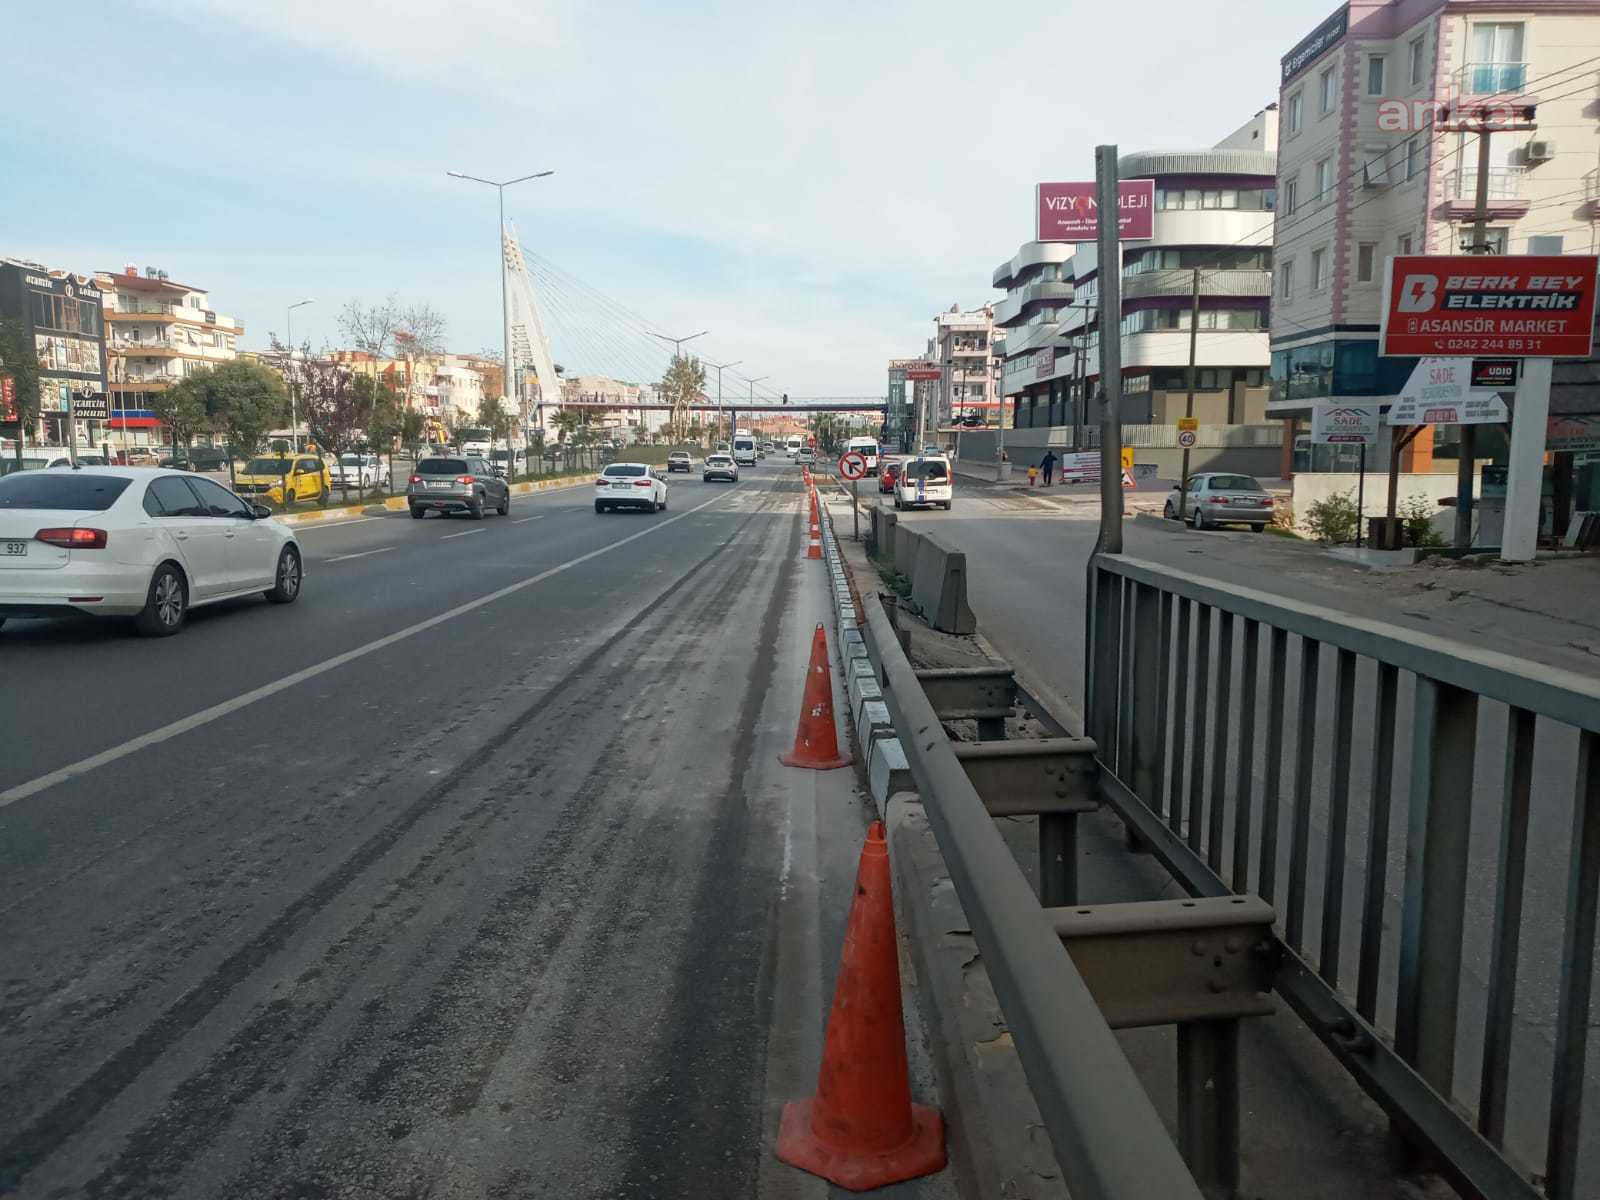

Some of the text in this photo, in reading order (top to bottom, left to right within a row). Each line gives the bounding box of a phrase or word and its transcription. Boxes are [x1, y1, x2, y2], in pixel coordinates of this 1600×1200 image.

[1445, 275, 1584, 290] BERK BEY
[1447, 293, 1576, 309] ELEKTRİK
[1420, 317, 1568, 333] ASANSÖR MARKET
[1448, 340, 1478, 350] 0242
[1481, 340, 1504, 350] 244
[7, 543, 25, 554] 937
